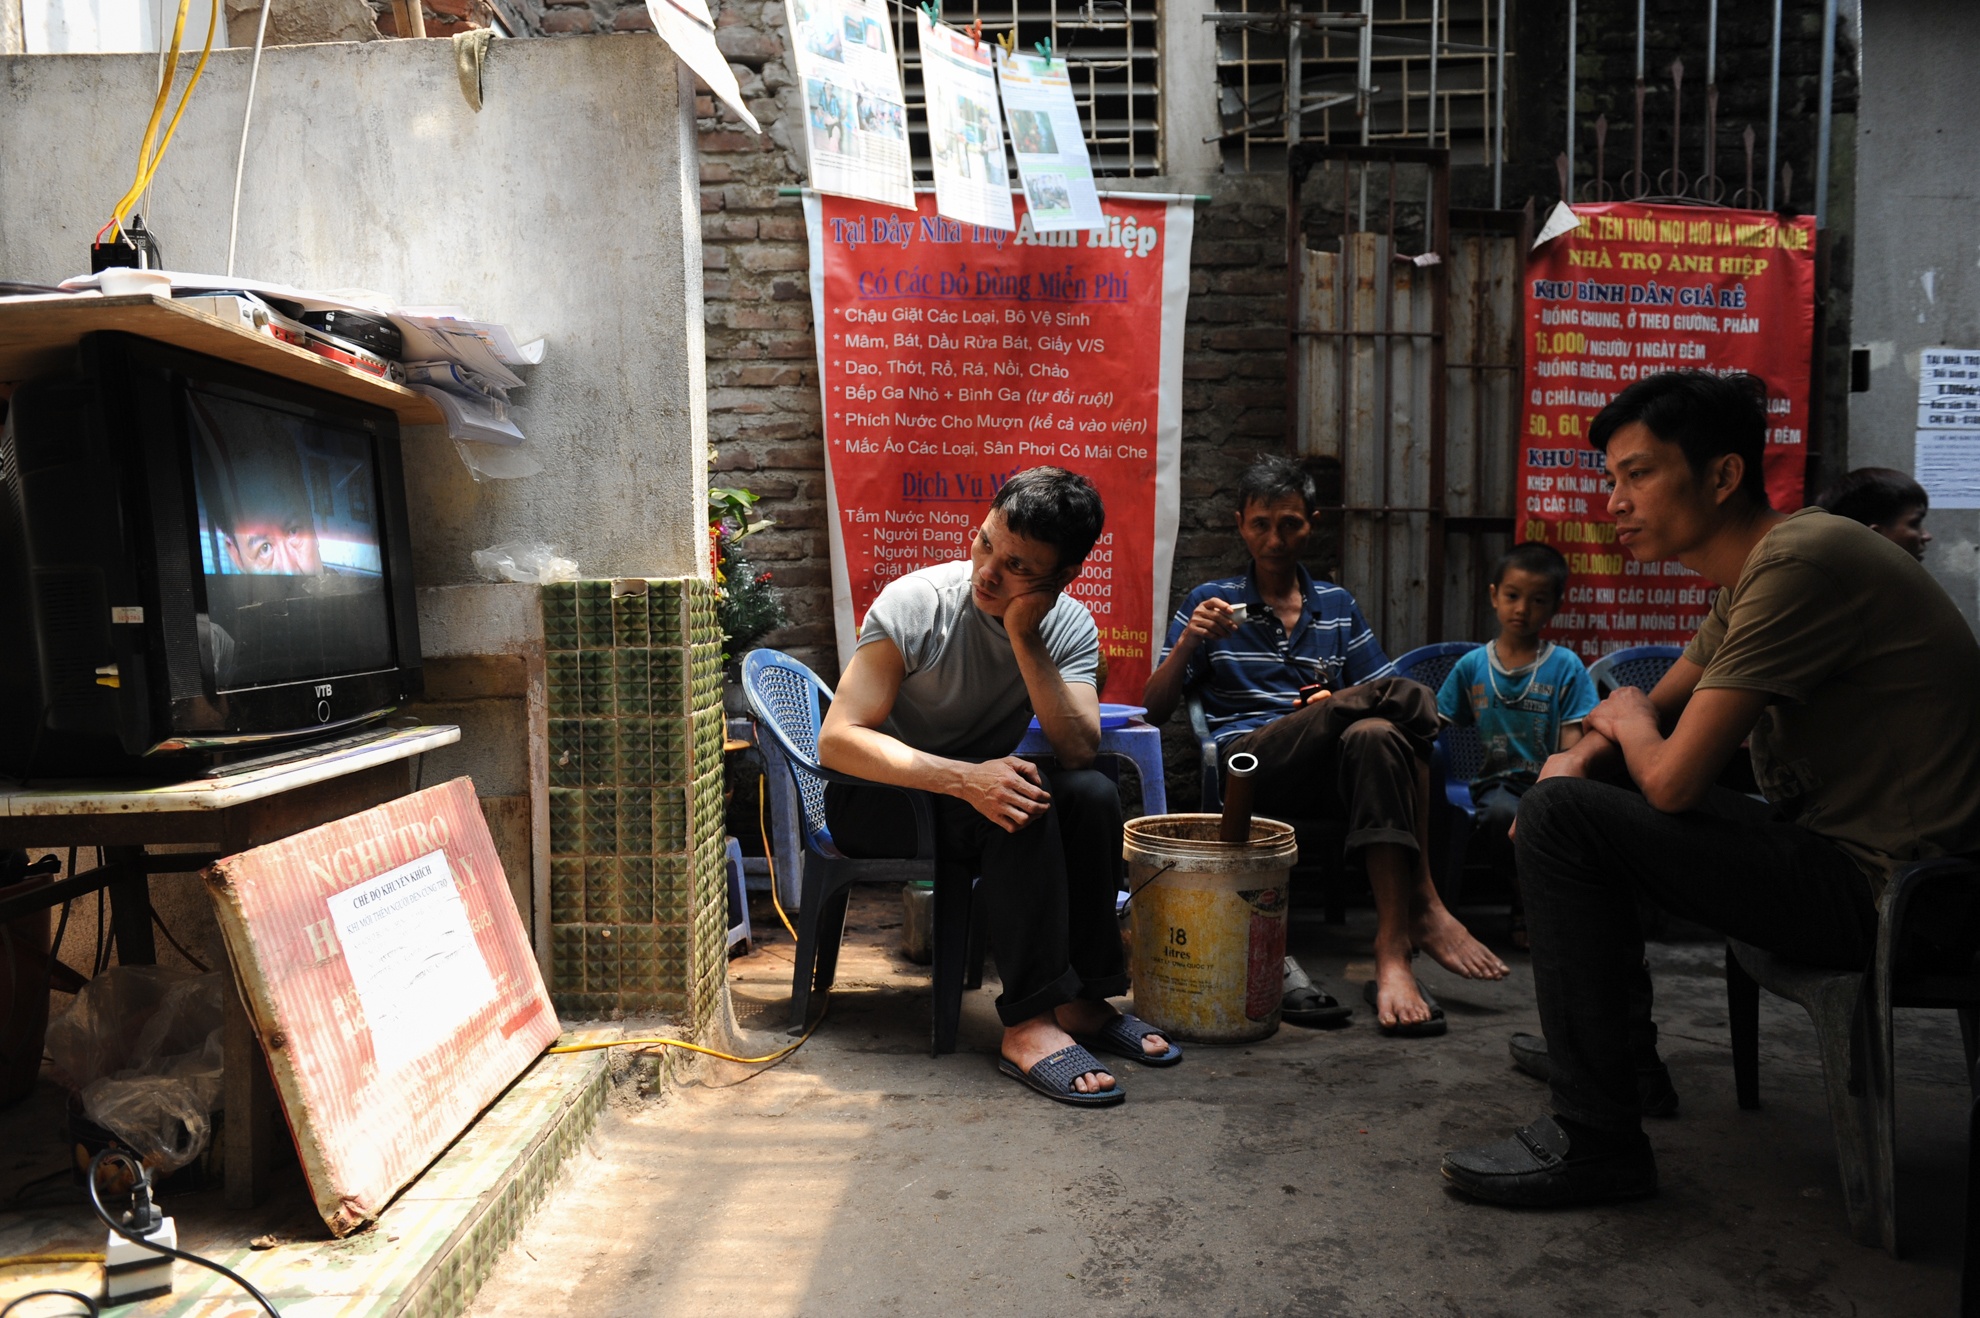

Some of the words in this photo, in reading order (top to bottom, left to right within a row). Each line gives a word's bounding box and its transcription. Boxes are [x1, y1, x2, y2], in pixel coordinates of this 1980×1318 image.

[830, 215, 866, 250] Tại
[872, 213, 915, 250] Đây
[1659, 219, 1686, 249] MỌI
[1715, 218, 1732, 246] VÀ
[1568, 247, 1613, 269] NHÀ
[1619, 251, 1663, 275] TRỌ
[1667, 254, 1713, 273] ANH
[1719, 254, 1769, 280] HIỆP
[858, 267, 888, 296] Có
[894, 265, 933, 295] Các
[976, 267, 1031, 300] Dùng
[1037, 265, 1086, 299] Miễn
[1095, 270, 1129, 299] Phí
[1533, 280, 1574, 300] KHU
[1577, 278, 1626, 304] BÌNH
[1629, 280, 1676, 305] DÂN
[1679, 282, 1715, 308] GIÁ
[1719, 282, 1747, 309] RẺ
[845, 308, 887, 325] Chậu
[892, 307, 923, 323] Giặt
[927, 308, 958, 324] Các
[962, 309, 999, 325] Loại,
[1005, 309, 1026, 324] Bô
[1030, 311, 1052, 327] Vệ
[1056, 312, 1090, 327] Sinh
[1581, 310, 1624, 330] CHUNG,
[1639, 312, 1671, 330] THEO
[845, 334, 889, 349] Mâm,
[894, 333, 923, 349] Bát,
[928, 333, 959, 349] Dầu
[964, 335, 997, 349] Rửa
[1002, 335, 1032, 351] Bát,
[1038, 335, 1072, 355] Giấy
[1076, 338, 1105, 353] V/S
[1679, 341, 1707, 360] ĐÊM
[845, 361, 882, 376] Dao,
[887, 359, 926, 376] Thớt,
[931, 360, 957, 378] Rổ,
[962, 362, 988, 377] Rá,
[993, 360, 1023, 378] Nồi,
[1029, 363, 1069, 379] Chảo
[1620, 361, 1638, 381] CÓ
[845, 383, 877, 403] Bếp
[881, 385, 904, 400] Ga
[909, 386, 939, 401] Nhỏ
[958, 387, 993, 402] Bình
[998, 387, 1021, 401] Ga
[1026, 389, 1049, 405] (tự
[1078, 392, 1114, 408] ruột)
[1545, 386, 1577, 406] CHÌA
[1578, 389, 1607, 408] KHÓA
[845, 413, 890, 427] Phích
[895, 412, 937, 428] Nước
[941, 415, 973, 429] Cho
[977, 414, 1023, 430] Mượn
[1028, 413, 1053, 432] (kể
[1057, 416, 1075, 431] cả
[1079, 418, 1107, 433] vào
[1111, 418, 1148, 435] viện)
[1529, 413, 1553, 439] 50,
[1558, 413, 1583, 439] 60,
[845, 437, 879, 454] Mắc
[883, 436, 904, 454] Áo
[908, 440, 938, 455] Các
[943, 441, 978, 457] Loại,
[983, 441, 1014, 455] Sân
[1018, 441, 1055, 456] Phơi
[1059, 443, 1081, 458] Có
[1085, 445, 1112, 459] Mái
[1116, 445, 1148, 459] Che
[1527, 447, 1576, 469] KHU
[902, 471, 948, 503] Dịch
[955, 473, 983, 503] Vụ
[1543, 494, 1566, 513] CÁC
[845, 507, 880, 523] Tắm
[885, 509, 925, 524] Nước
[929, 511, 970, 527] Nóng
[873, 528, 918, 544] Người
[922, 528, 963, 545] Đang
[873, 545, 918, 561] Người
[923, 546, 967, 561] Ngoài
[873, 562, 902, 577] Giặt
[1569, 585, 1592, 603] CÁC
[1618, 585, 1643, 604] CÁC
[1648, 588, 1676, 609] LOẠI
[1112, 625, 1148, 644] bằng
[1110, 644, 1144, 658] khăn
[314, 684, 333, 698] VTB
[1168, 926, 1187, 946] 18
[1163, 946, 1191, 960] litres
